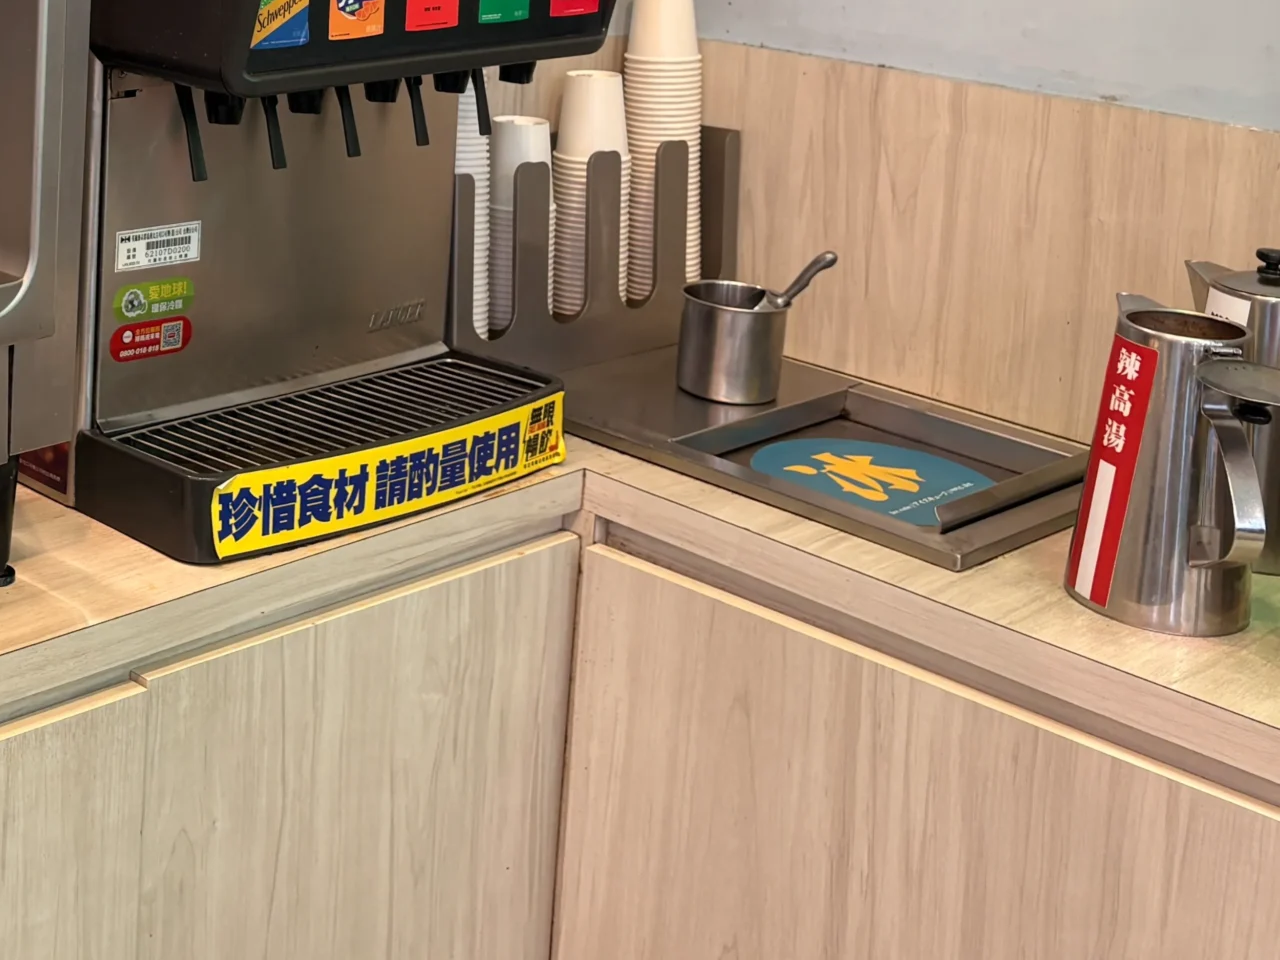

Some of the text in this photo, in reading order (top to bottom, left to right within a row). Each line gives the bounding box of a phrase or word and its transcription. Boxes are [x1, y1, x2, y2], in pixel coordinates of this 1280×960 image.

[145, 245, 191, 258] 62107D0200
[149, 282, 187, 300] 愛地球!
[529, 401, 556, 428] 無限
[1103, 348, 1142, 453] 辣高湯
[523, 428, 553, 462] 暢飲
[217, 421, 521, 543] 珍惜食材 請酌量使用
[783, 452, 926, 501] 冰
